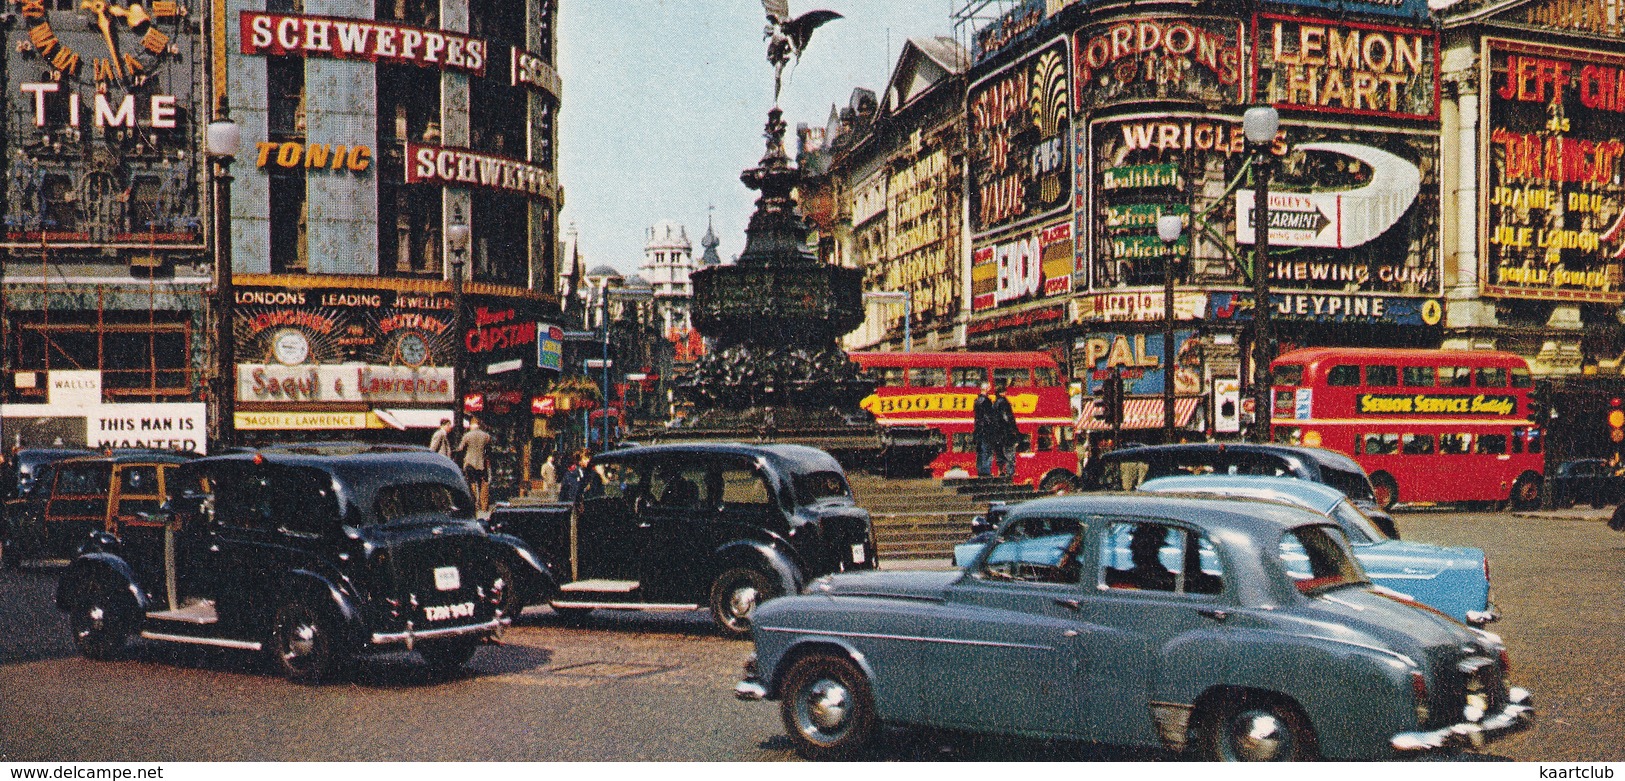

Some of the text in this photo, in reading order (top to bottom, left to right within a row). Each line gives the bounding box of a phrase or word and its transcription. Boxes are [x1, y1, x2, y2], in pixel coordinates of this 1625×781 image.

[252, 16, 483, 69] SCHWEPPES
[1272, 21, 1423, 76] LEMON
[1287, 64, 1409, 112] HART
[1497, 55, 1572, 104] JEFF
[20, 82, 177, 128] TIME
[256, 141, 372, 171] TONIC
[1490, 185, 1602, 213] JOANNE DRU
[1490, 225, 1599, 250] JULIE LONDON
[1379, 266, 1432, 285] GUM
[321, 294, 381, 307] LEADING
[1278, 295, 1386, 315] JEYPINE
[379, 313, 447, 335] ROTARY
[465, 320, 536, 352] CAPSTAN
[1085, 334, 1159, 369] PAL
[357, 367, 449, 395] Lawrence
[1361, 394, 1411, 411] SENIOR
[1413, 395, 1468, 412] SERVICE
[100, 417, 194, 431] THIS MAN IS
